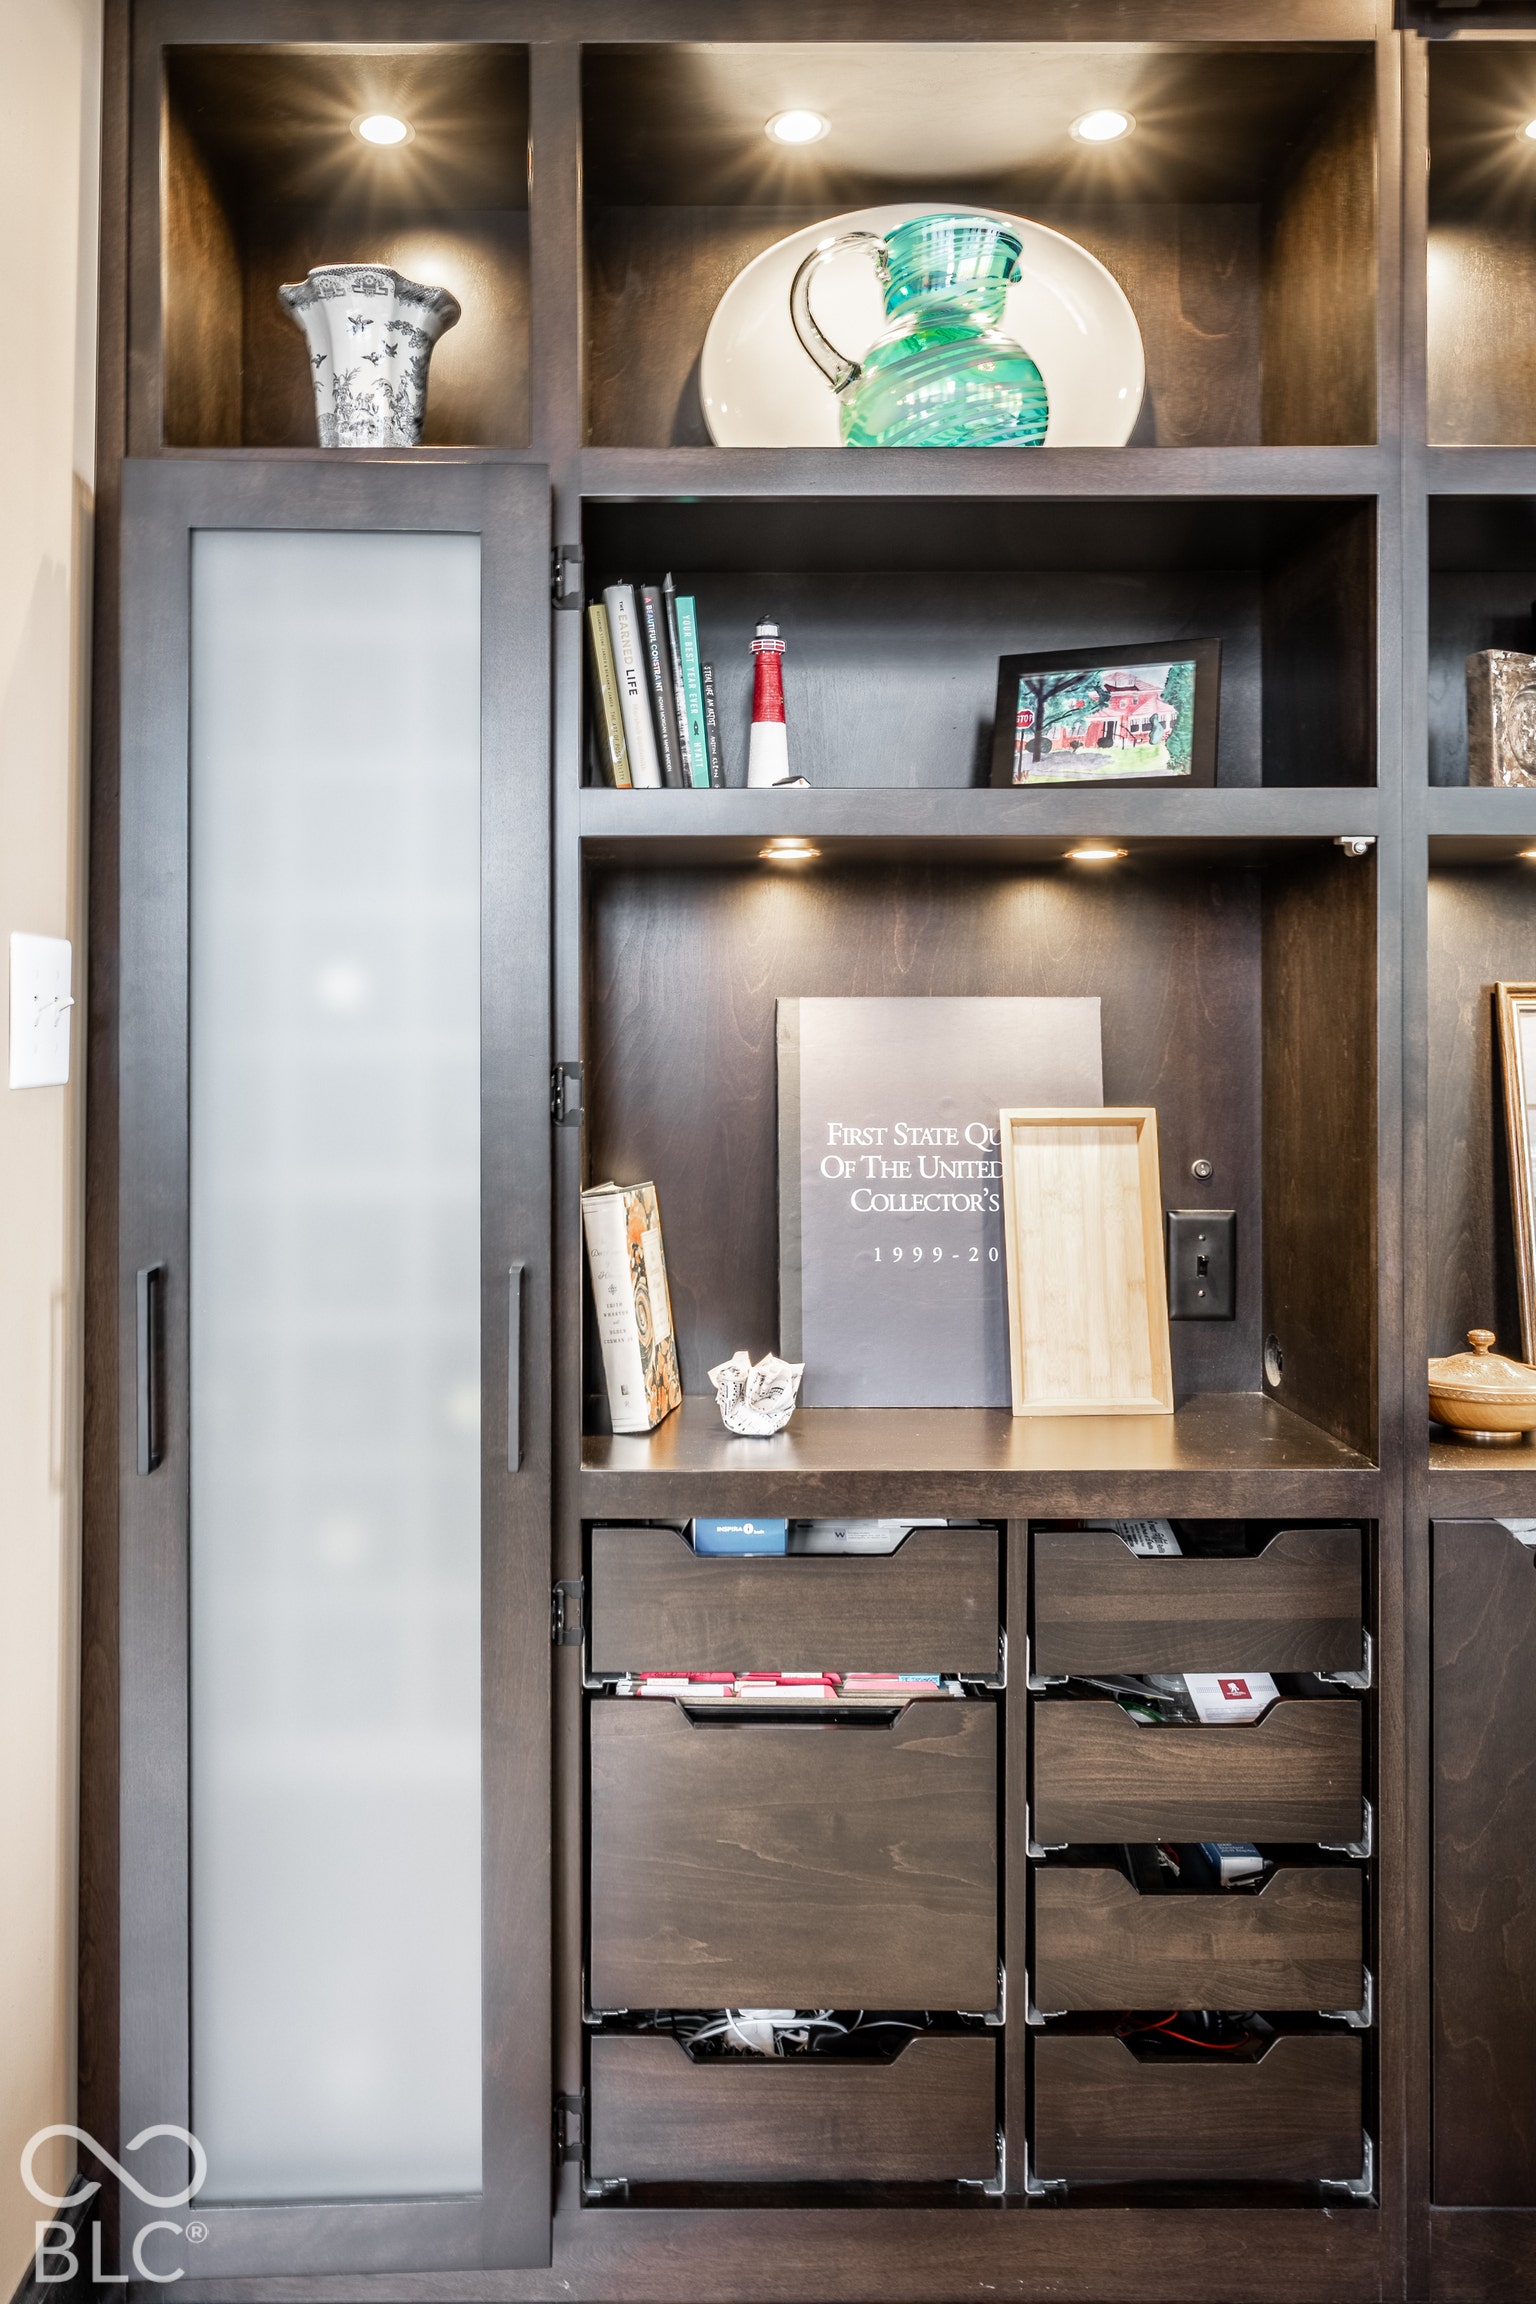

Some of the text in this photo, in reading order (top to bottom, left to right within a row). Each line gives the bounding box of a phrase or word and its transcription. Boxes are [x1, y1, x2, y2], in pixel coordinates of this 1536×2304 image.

[646, 604, 657, 643] BEAUTIFUL
[618, 614, 634, 666] EARNED
[626, 669, 638, 696] LIFE
[651, 644, 663, 692] CONSTRAINT
[703, 665, 713, 684] STEAL
[682, 614, 704, 767] YOUR BEST YEAR EVER HYATT
[706, 698, 714, 707] AN
[706, 707, 716, 727] ARTIST
[613, 735, 620, 743] OF
[826, 1122, 888, 1146] FIRST
[893, 1122, 960, 1146] STATE
[820, 1155, 857, 1180] OF
[860, 1154, 912, 1179] THE
[850, 1187, 1001, 1213] COLLECTOR'S
